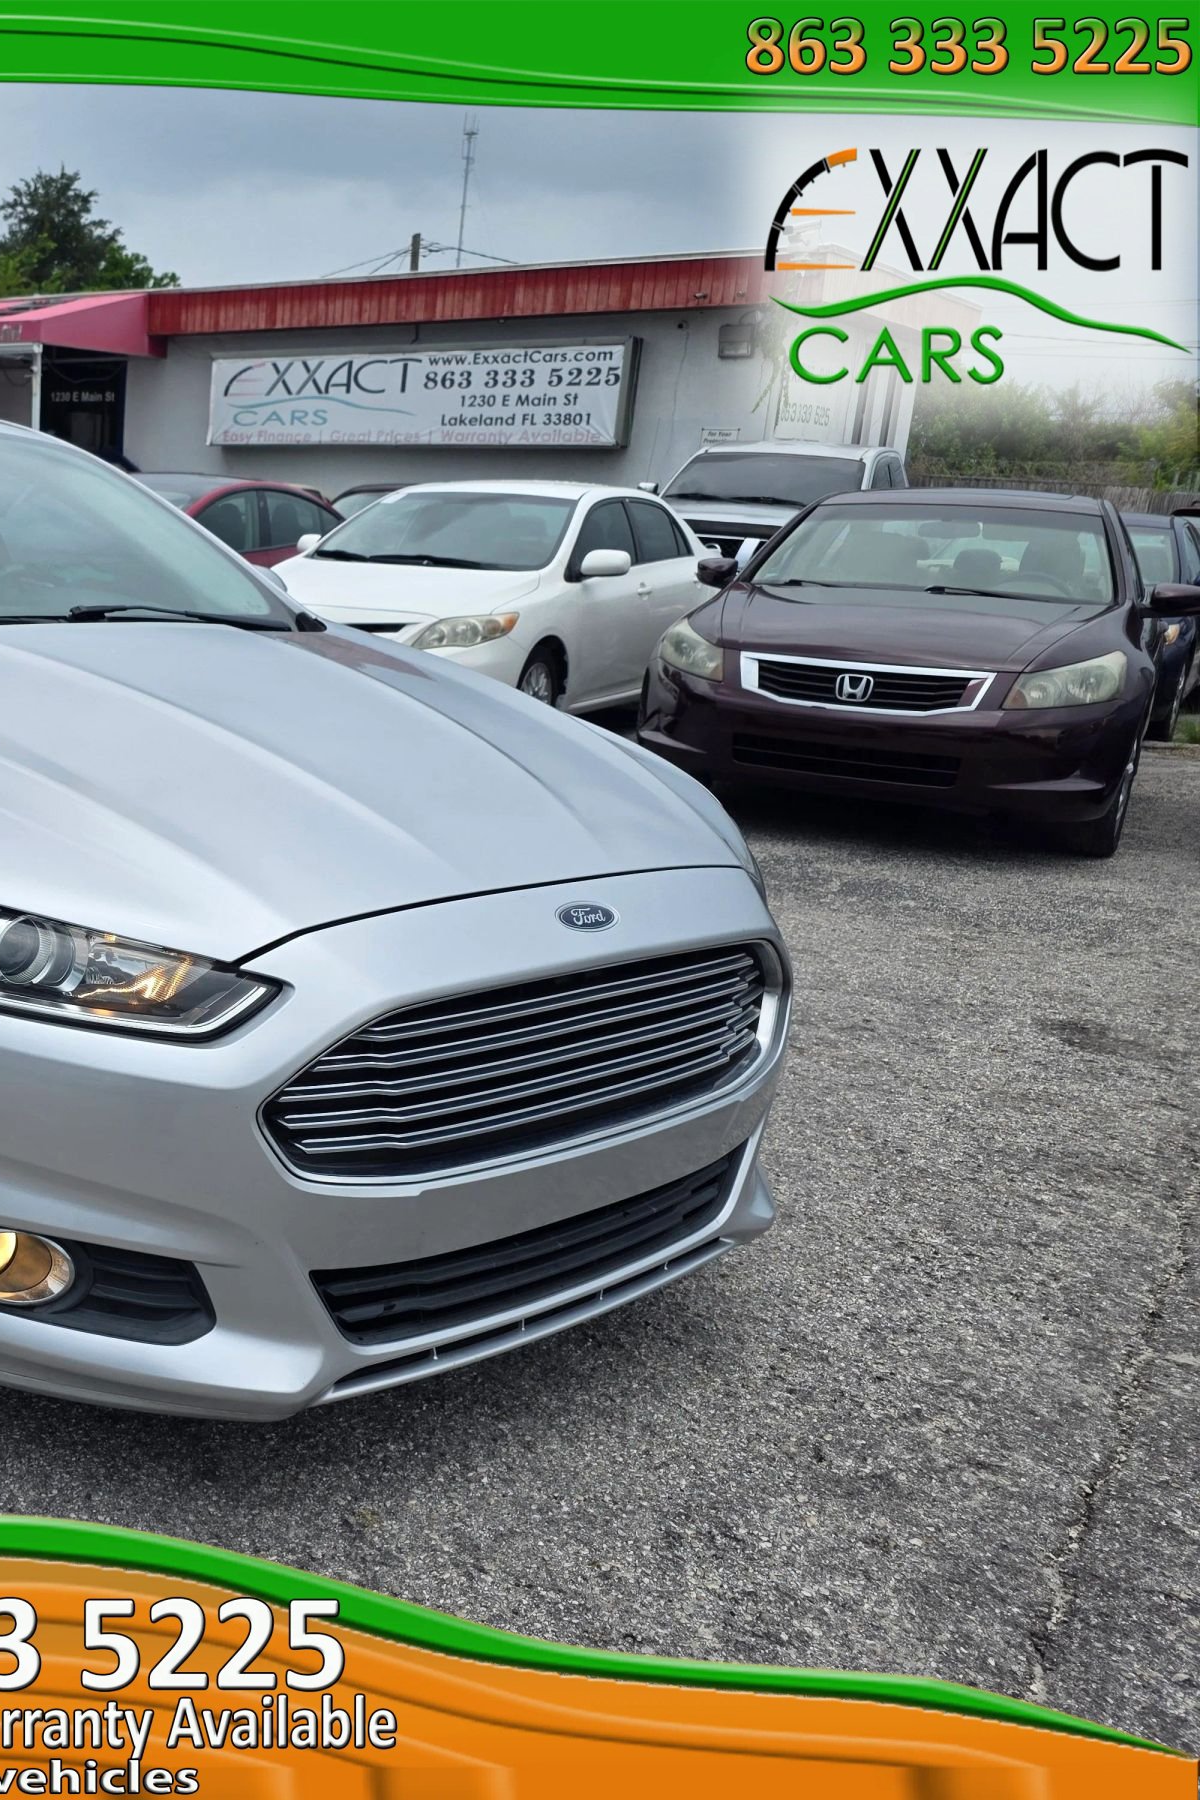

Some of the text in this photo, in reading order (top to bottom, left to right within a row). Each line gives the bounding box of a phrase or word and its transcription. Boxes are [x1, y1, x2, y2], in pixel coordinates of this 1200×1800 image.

[428, 350, 613, 366] www.ExxactCars.com
[224, 358, 422, 397] EXXACT
[423, 366, 621, 390] 863 333 5225
[81, 391, 103, 402] Main
[460, 393, 579, 408] 1230 E Main St
[233, 410, 328, 426] CARS
[441, 413, 592, 427] Lakeland FL 33801
[441, 430, 512, 445] Warranty
[518, 428, 600, 443] Available
[570, 908, 606, 925] Ford
